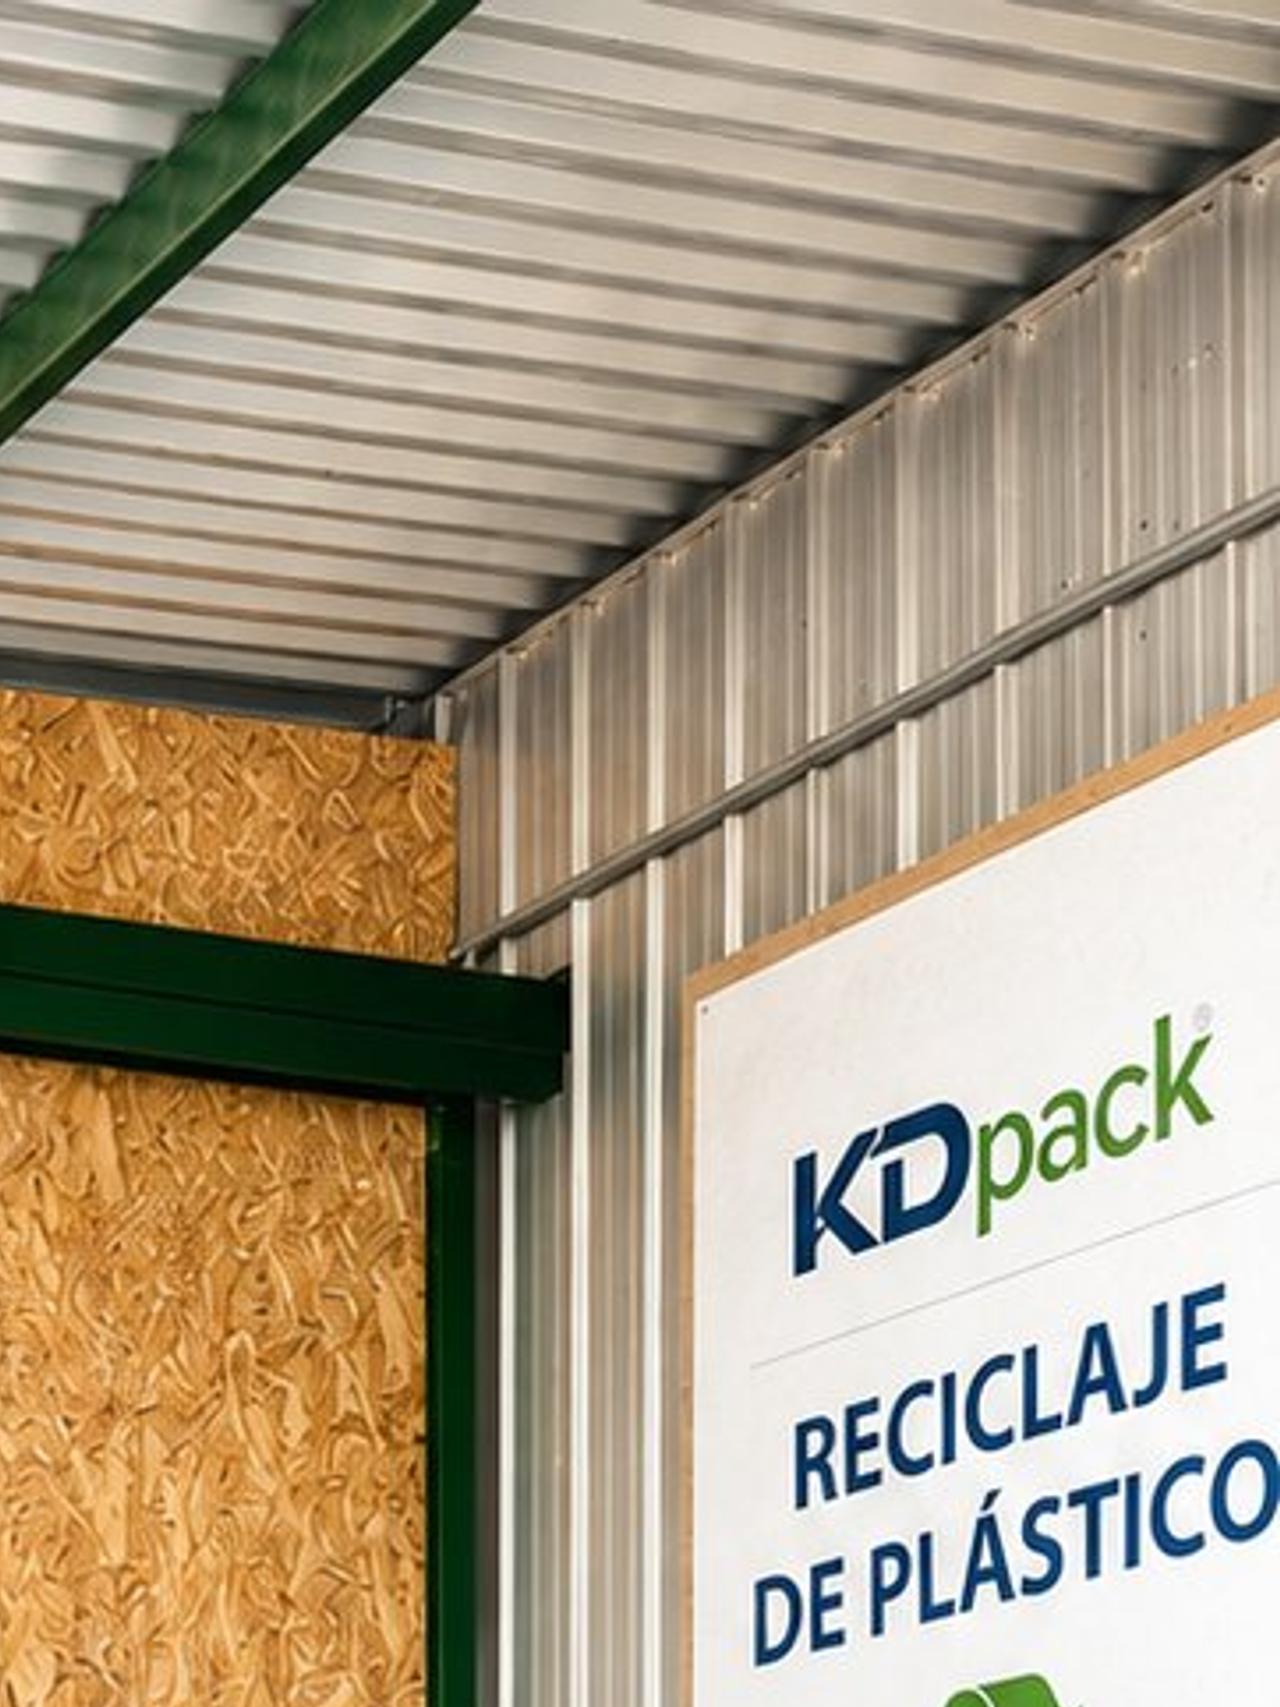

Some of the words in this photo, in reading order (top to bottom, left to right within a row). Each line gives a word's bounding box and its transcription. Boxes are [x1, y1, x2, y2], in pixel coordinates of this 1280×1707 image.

[792, 1013, 1215, 1278] KDpack
[794, 1282, 1227, 1511] RECICLAJE
[754, 1556, 846, 1667] DE
[870, 1439, 1280, 1637] PLÁSTICO
